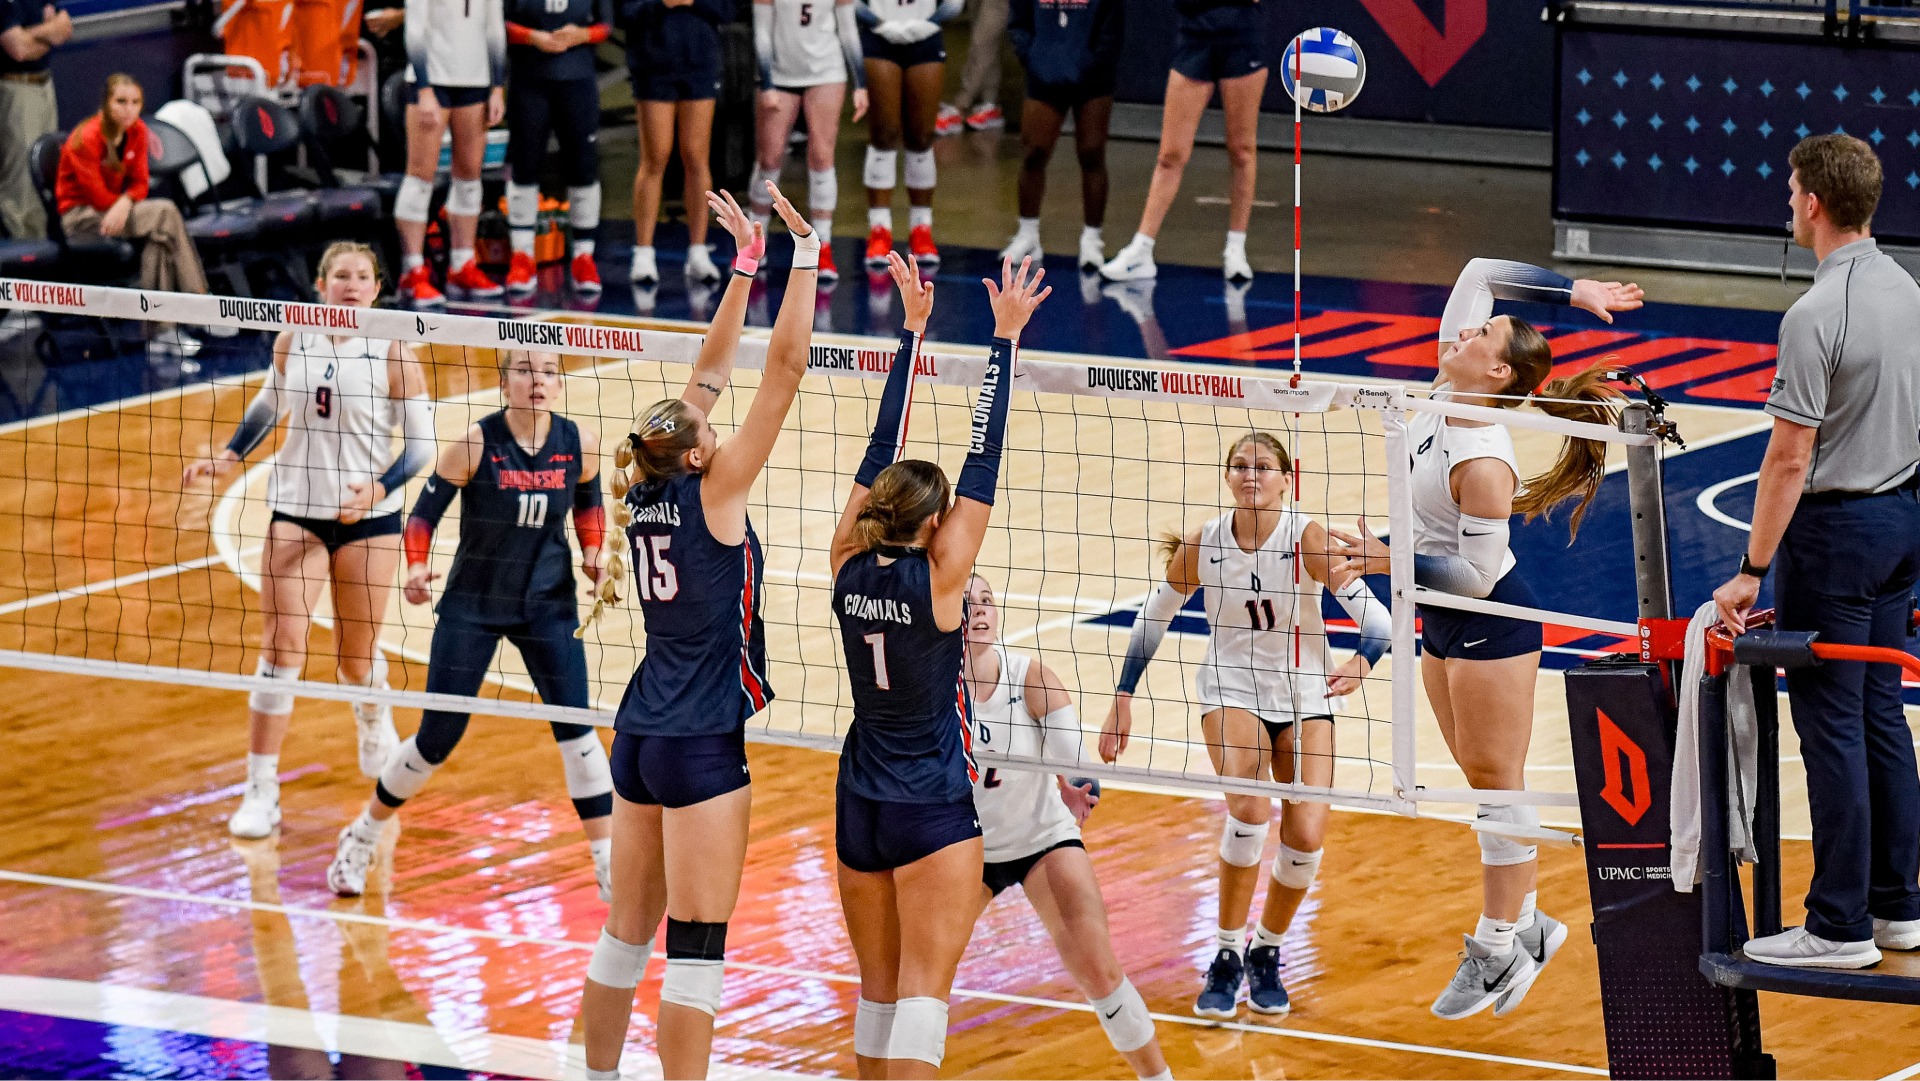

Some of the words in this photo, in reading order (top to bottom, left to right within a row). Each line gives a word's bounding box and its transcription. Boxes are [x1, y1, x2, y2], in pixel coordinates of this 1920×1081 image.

[801, 3, 812, 27] 5
[14, 282, 86, 307] VOLLEYBALL
[219, 298, 282, 323] DUQUESNE
[284, 304, 359, 330] VOLLEYBALL
[498, 321, 564, 346] DUQUESNE
[565, 326, 644, 352] VOLLEYBALL
[1087, 366, 1159, 393] DUQUESNE
[1160, 371, 1245, 399] VOLLEYBALL
[316, 386, 332, 419] 9
[969, 363, 1001, 455] COLONIALS
[517, 492, 549, 529] 10
[635, 534, 680, 602] 15
[844, 593, 912, 625] COLONIALS
[1244, 598, 1277, 631] 11
[863, 631, 891, 691] 1
[1597, 866, 1642, 880] UPMC
